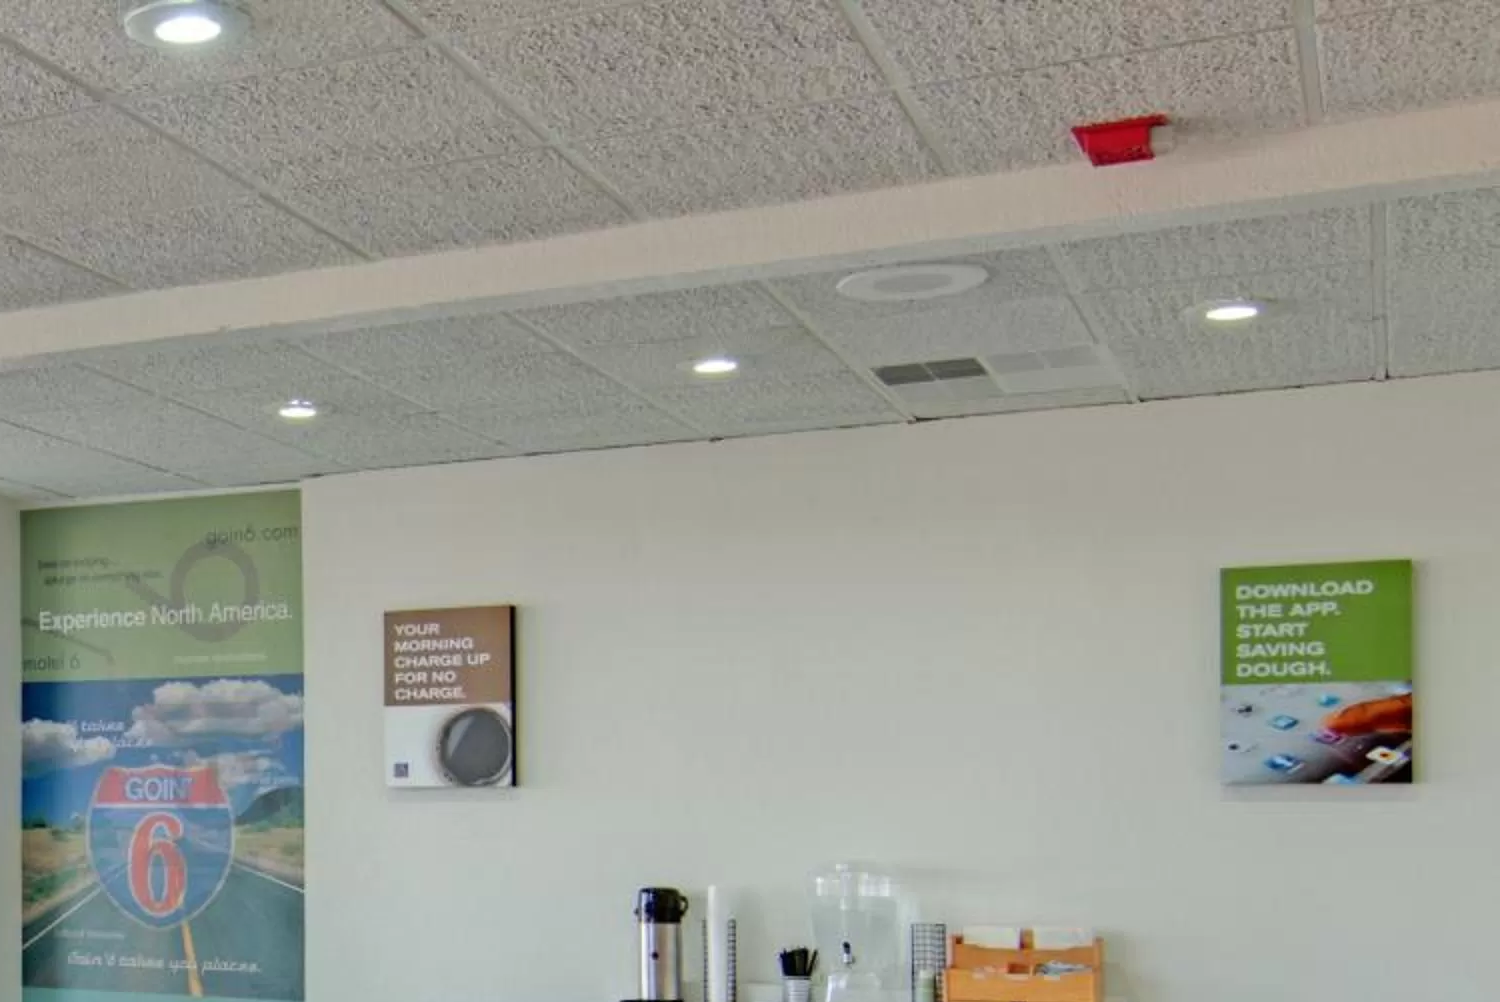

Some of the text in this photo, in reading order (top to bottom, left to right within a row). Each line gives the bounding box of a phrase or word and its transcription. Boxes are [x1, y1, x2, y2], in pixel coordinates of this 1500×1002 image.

[1236, 579, 1374, 600] DOWNLOAD
[39, 600, 293, 635] Experience North America.
[1236, 601, 1341, 619] THE APP.
[394, 622, 440, 637] YOUR
[1236, 622, 1308, 639] START
[394, 637, 474, 653] MORNING
[1236, 641, 1325, 658] SAVING
[394, 653, 491, 669] CHARGE UP
[1236, 660, 1332, 678] DOUGH.
[395, 670, 457, 685] FOR NO
[394, 686, 466, 700] CHARGE.
[127, 810, 188, 918] 6
